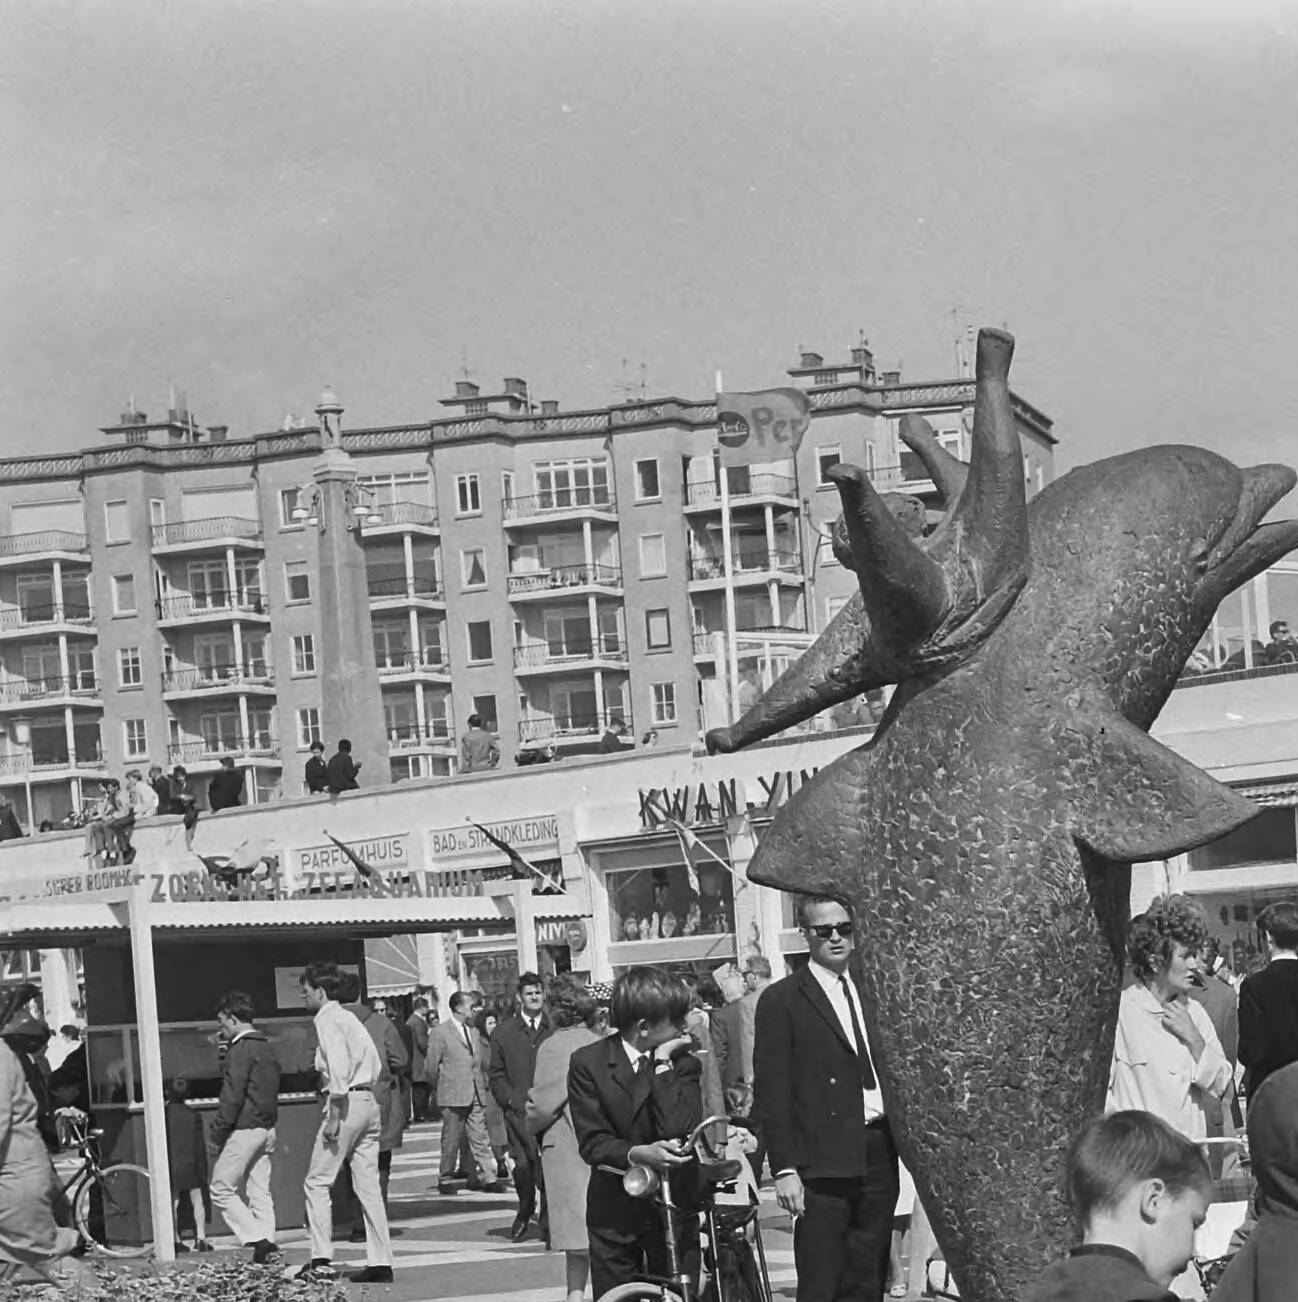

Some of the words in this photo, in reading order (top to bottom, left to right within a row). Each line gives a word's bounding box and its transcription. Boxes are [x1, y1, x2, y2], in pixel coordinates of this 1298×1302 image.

[638, 778, 737, 827] KWAN
[433, 833, 457, 853] BAD
[469, 818, 559, 849] STRANDKLEDING
[301, 870, 486, 900] ZEEAQUARIUM
[538, 922, 567, 942] NIV
